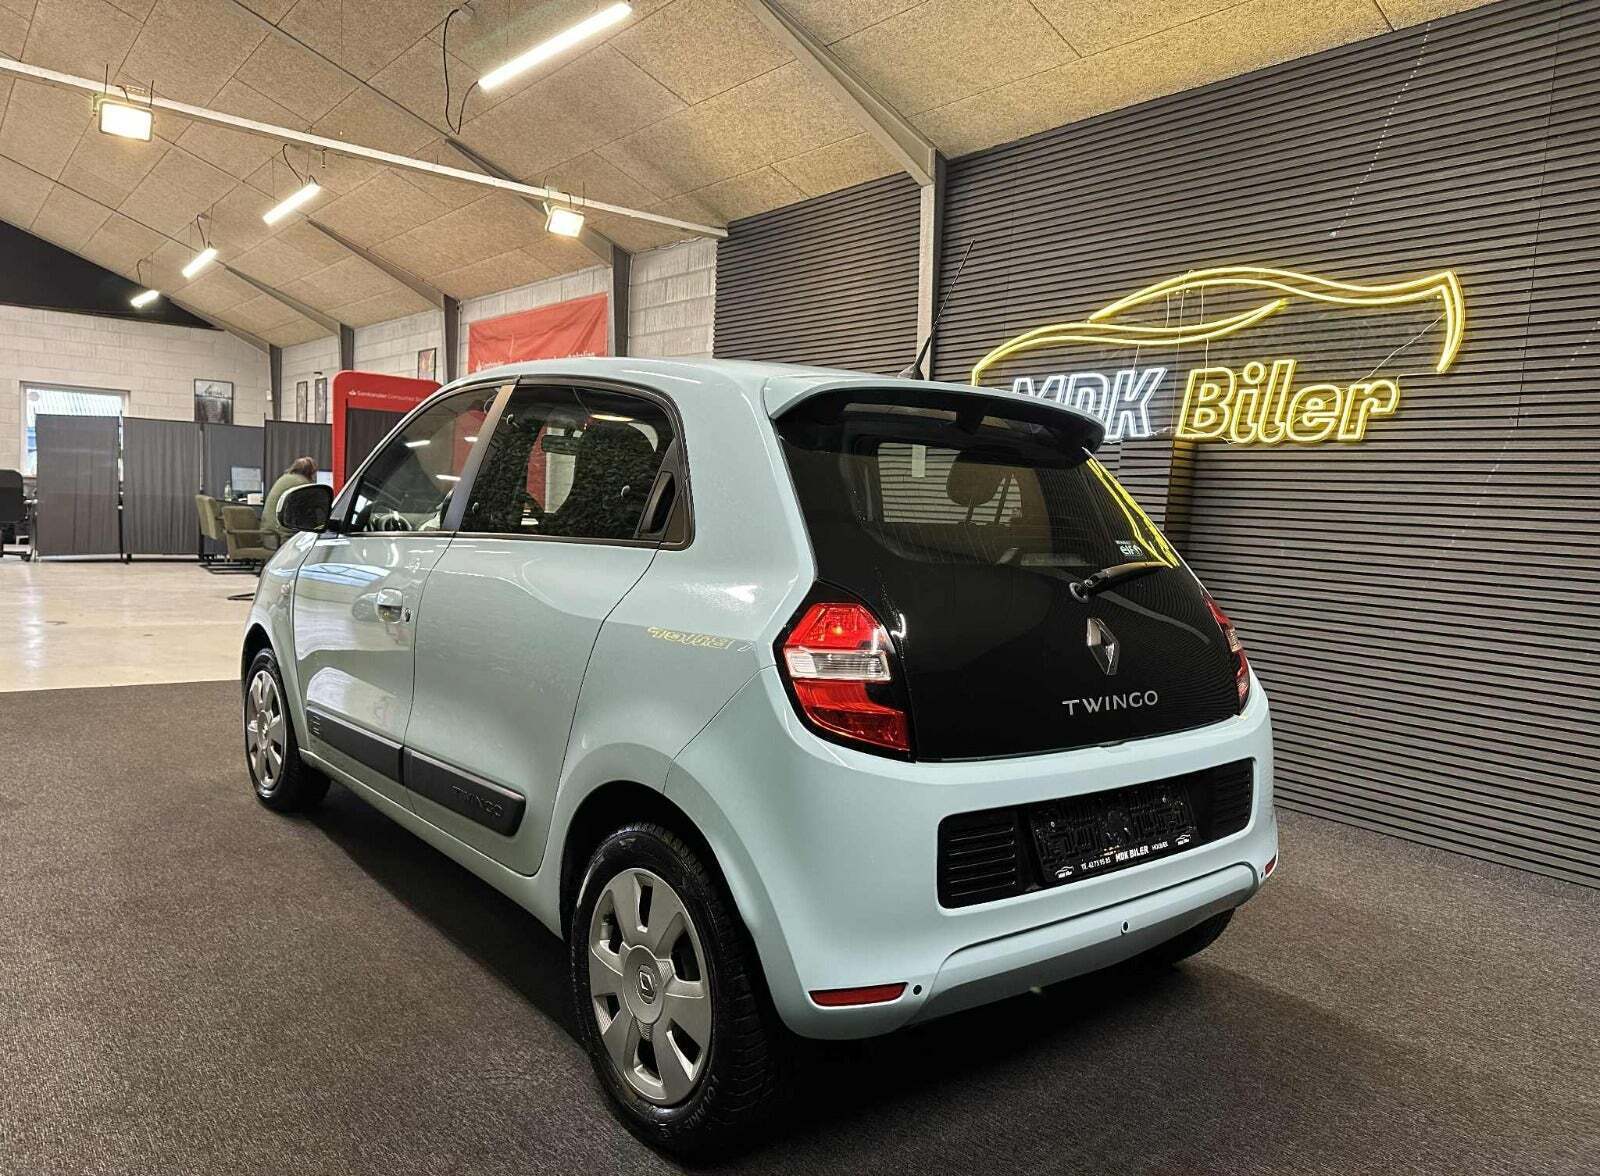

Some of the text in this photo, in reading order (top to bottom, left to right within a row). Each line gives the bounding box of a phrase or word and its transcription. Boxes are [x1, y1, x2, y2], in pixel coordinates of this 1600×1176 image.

[1176, 359, 1401, 443] Biler
[1062, 690, 1158, 716] TWINGO
[1115, 851, 1129, 862] MDK
[1129, 845, 1149, 858] BILER
